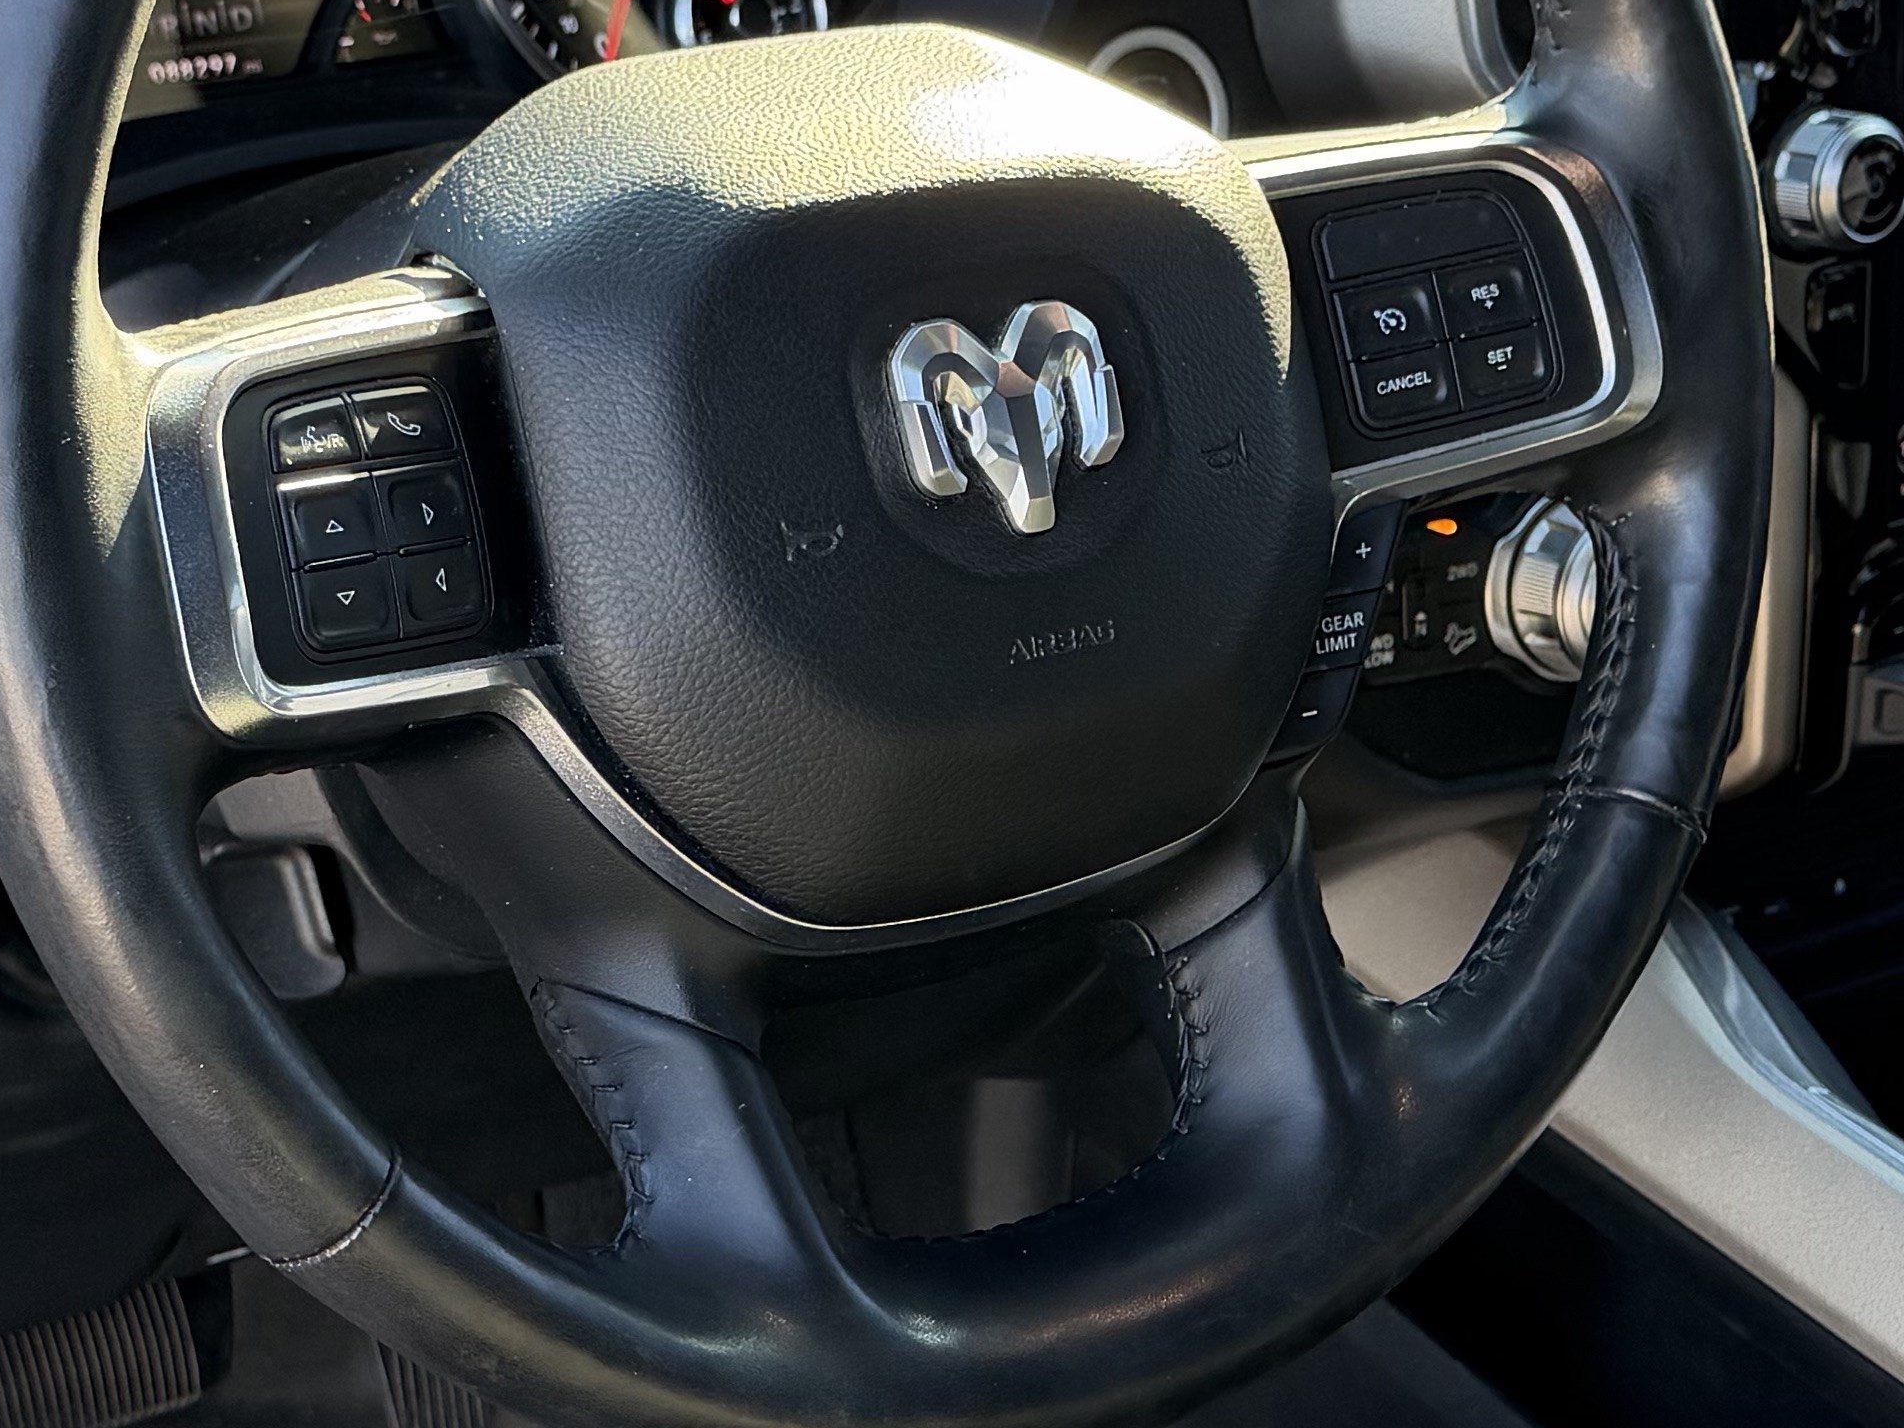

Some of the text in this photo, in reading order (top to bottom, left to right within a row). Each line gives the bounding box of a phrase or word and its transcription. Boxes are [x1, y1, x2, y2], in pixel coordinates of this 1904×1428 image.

[1470, 283, 1501, 303] RES
[1486, 345, 1514, 366] SET
[1375, 370, 1433, 397] CANCEL
[1321, 610, 1366, 635] GEAR
[1008, 619, 1116, 665] AIRBAG
[1314, 633, 1360, 655] LIMIT
